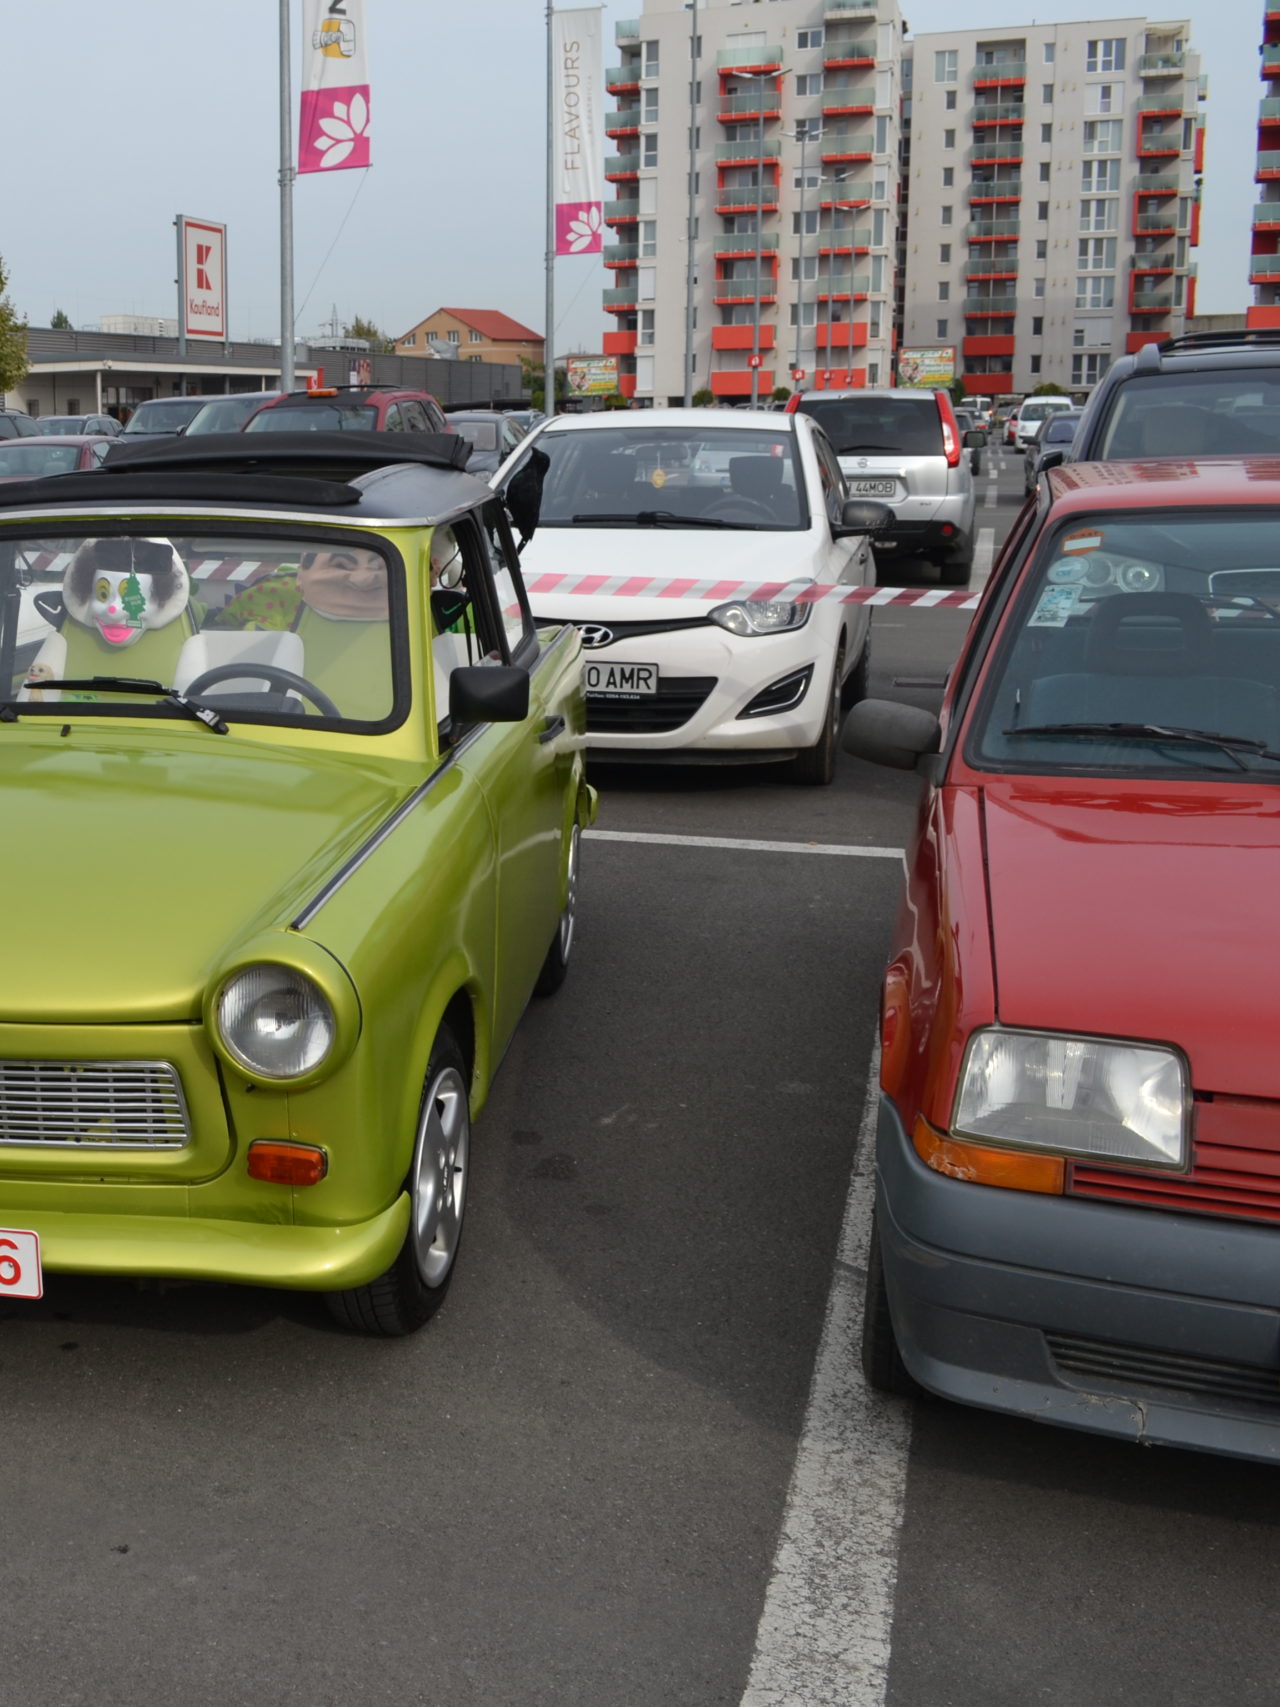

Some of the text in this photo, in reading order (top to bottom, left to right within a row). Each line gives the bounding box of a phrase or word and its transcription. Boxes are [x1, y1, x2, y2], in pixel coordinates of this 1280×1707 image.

[564, 41, 580, 170] FLAVOURS
[197, 243, 213, 291] K
[189, 299, 221, 317] Kaufland
[606, 667, 653, 690] AMR
